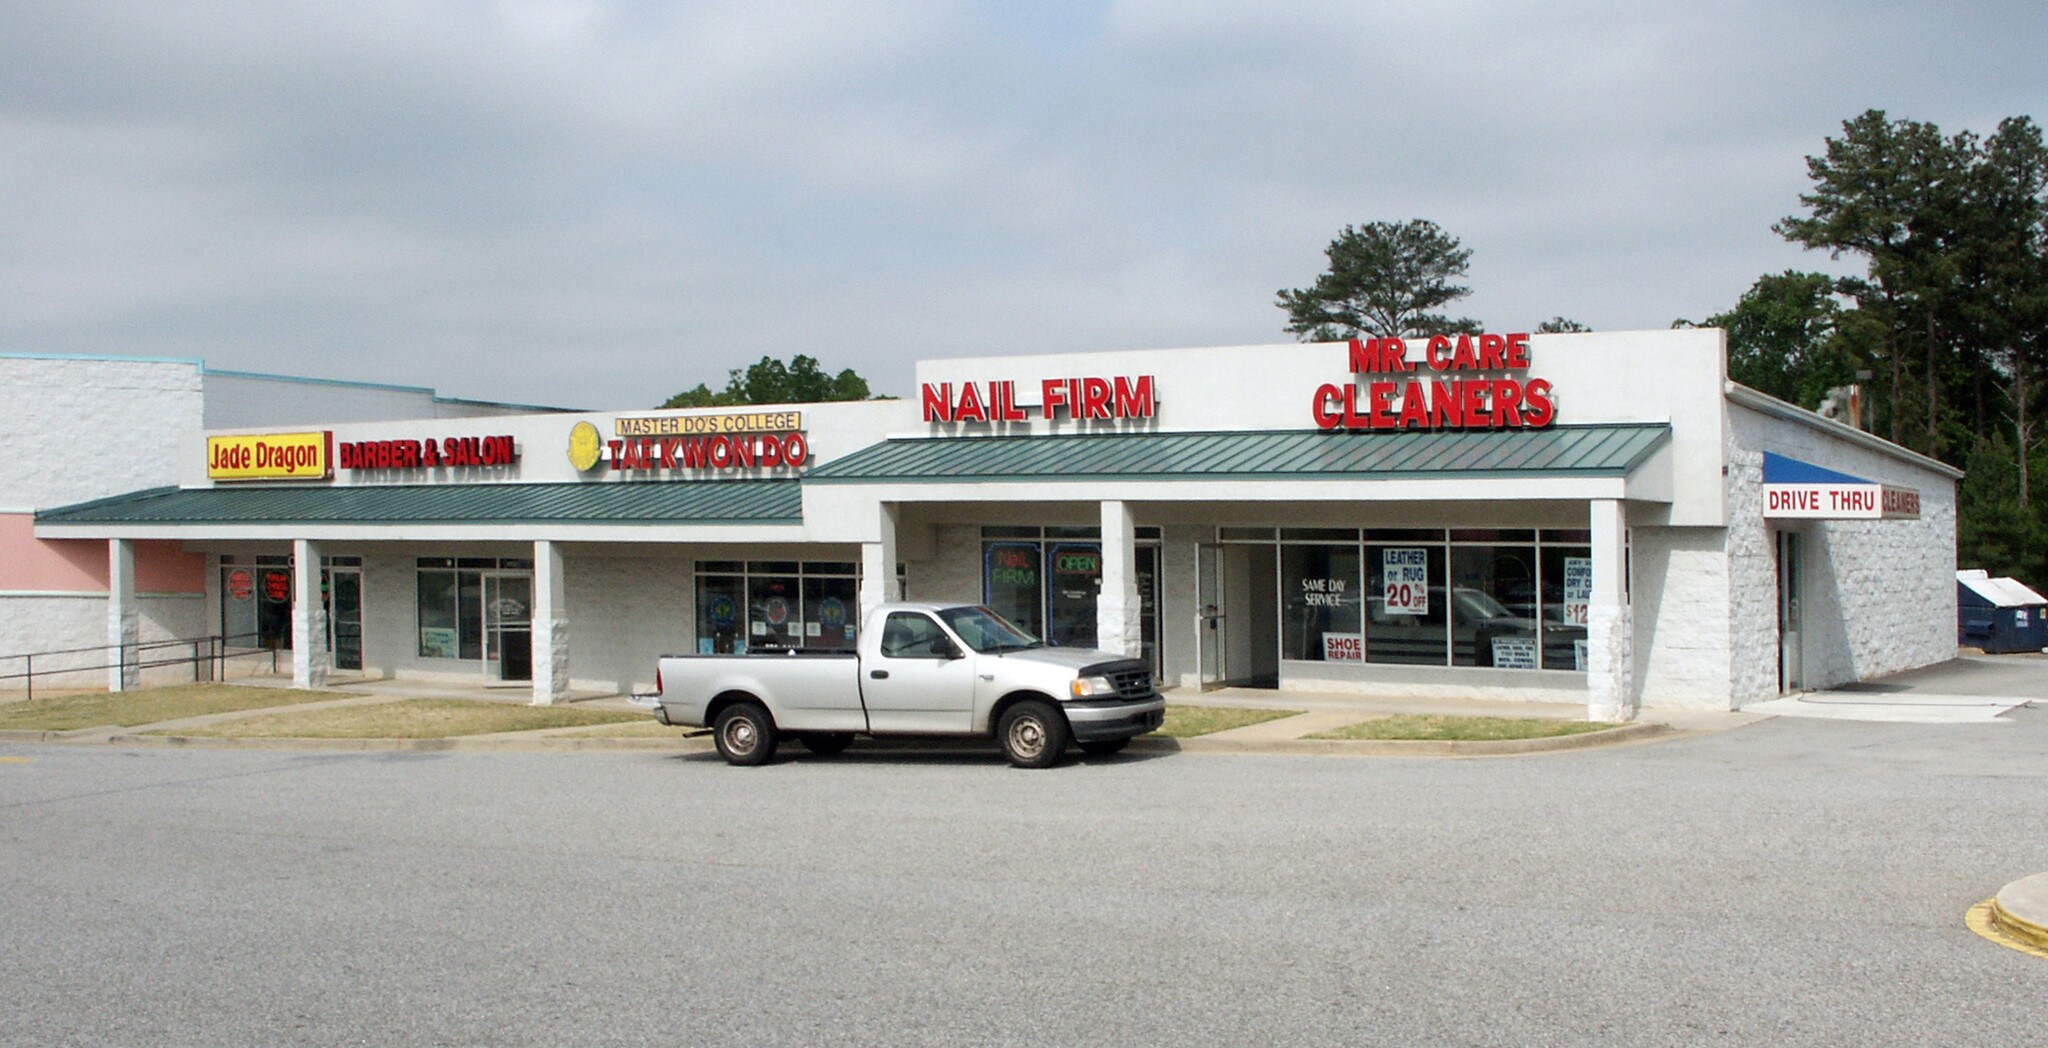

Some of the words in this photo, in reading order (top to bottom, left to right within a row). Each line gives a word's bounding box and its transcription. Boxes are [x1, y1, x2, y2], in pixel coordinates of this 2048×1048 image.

[1349, 336, 1417, 373] MR.
[1426, 333, 1531, 371] CARE
[922, 381, 1027, 422] NAIL
[1041, 375, 1155, 420] FIRM
[1312, 378, 1554, 430] CLEANERS
[621, 419, 678, 434] MASTER
[684, 416, 718, 432] DO'S
[724, 414, 796, 430] COLLEGE
[210, 443, 250, 469] Jade
[256, 442, 318, 474] Dragon
[340, 440, 421, 469] BARBER
[423, 438, 439, 467] &
[443, 435, 514, 467] SALON
[1769, 490, 1820, 511] DRIVE
[1829, 490, 1875, 511] THRU
[1882, 489, 1920, 515] CLEANERS
[1059, 556, 1096, 571] OPEN
[1385, 550, 1425, 565] LEATHER
[993, 568, 1035, 584] FIRM
[1388, 571, 1398, 581] or
[1402, 567, 1424, 581] RUG
[1302, 578, 1326, 592] SAME
[1328, 579, 1346, 592] DAY
[1566, 578, 1581, 587] DRY
[1305, 593, 1341, 607] SERVICE
[1387, 583, 1411, 607] 20
[1413, 596, 1426, 608] OFF
[1327, 638, 1361, 650] SHOE
[1328, 650, 1361, 660] REPAIR
